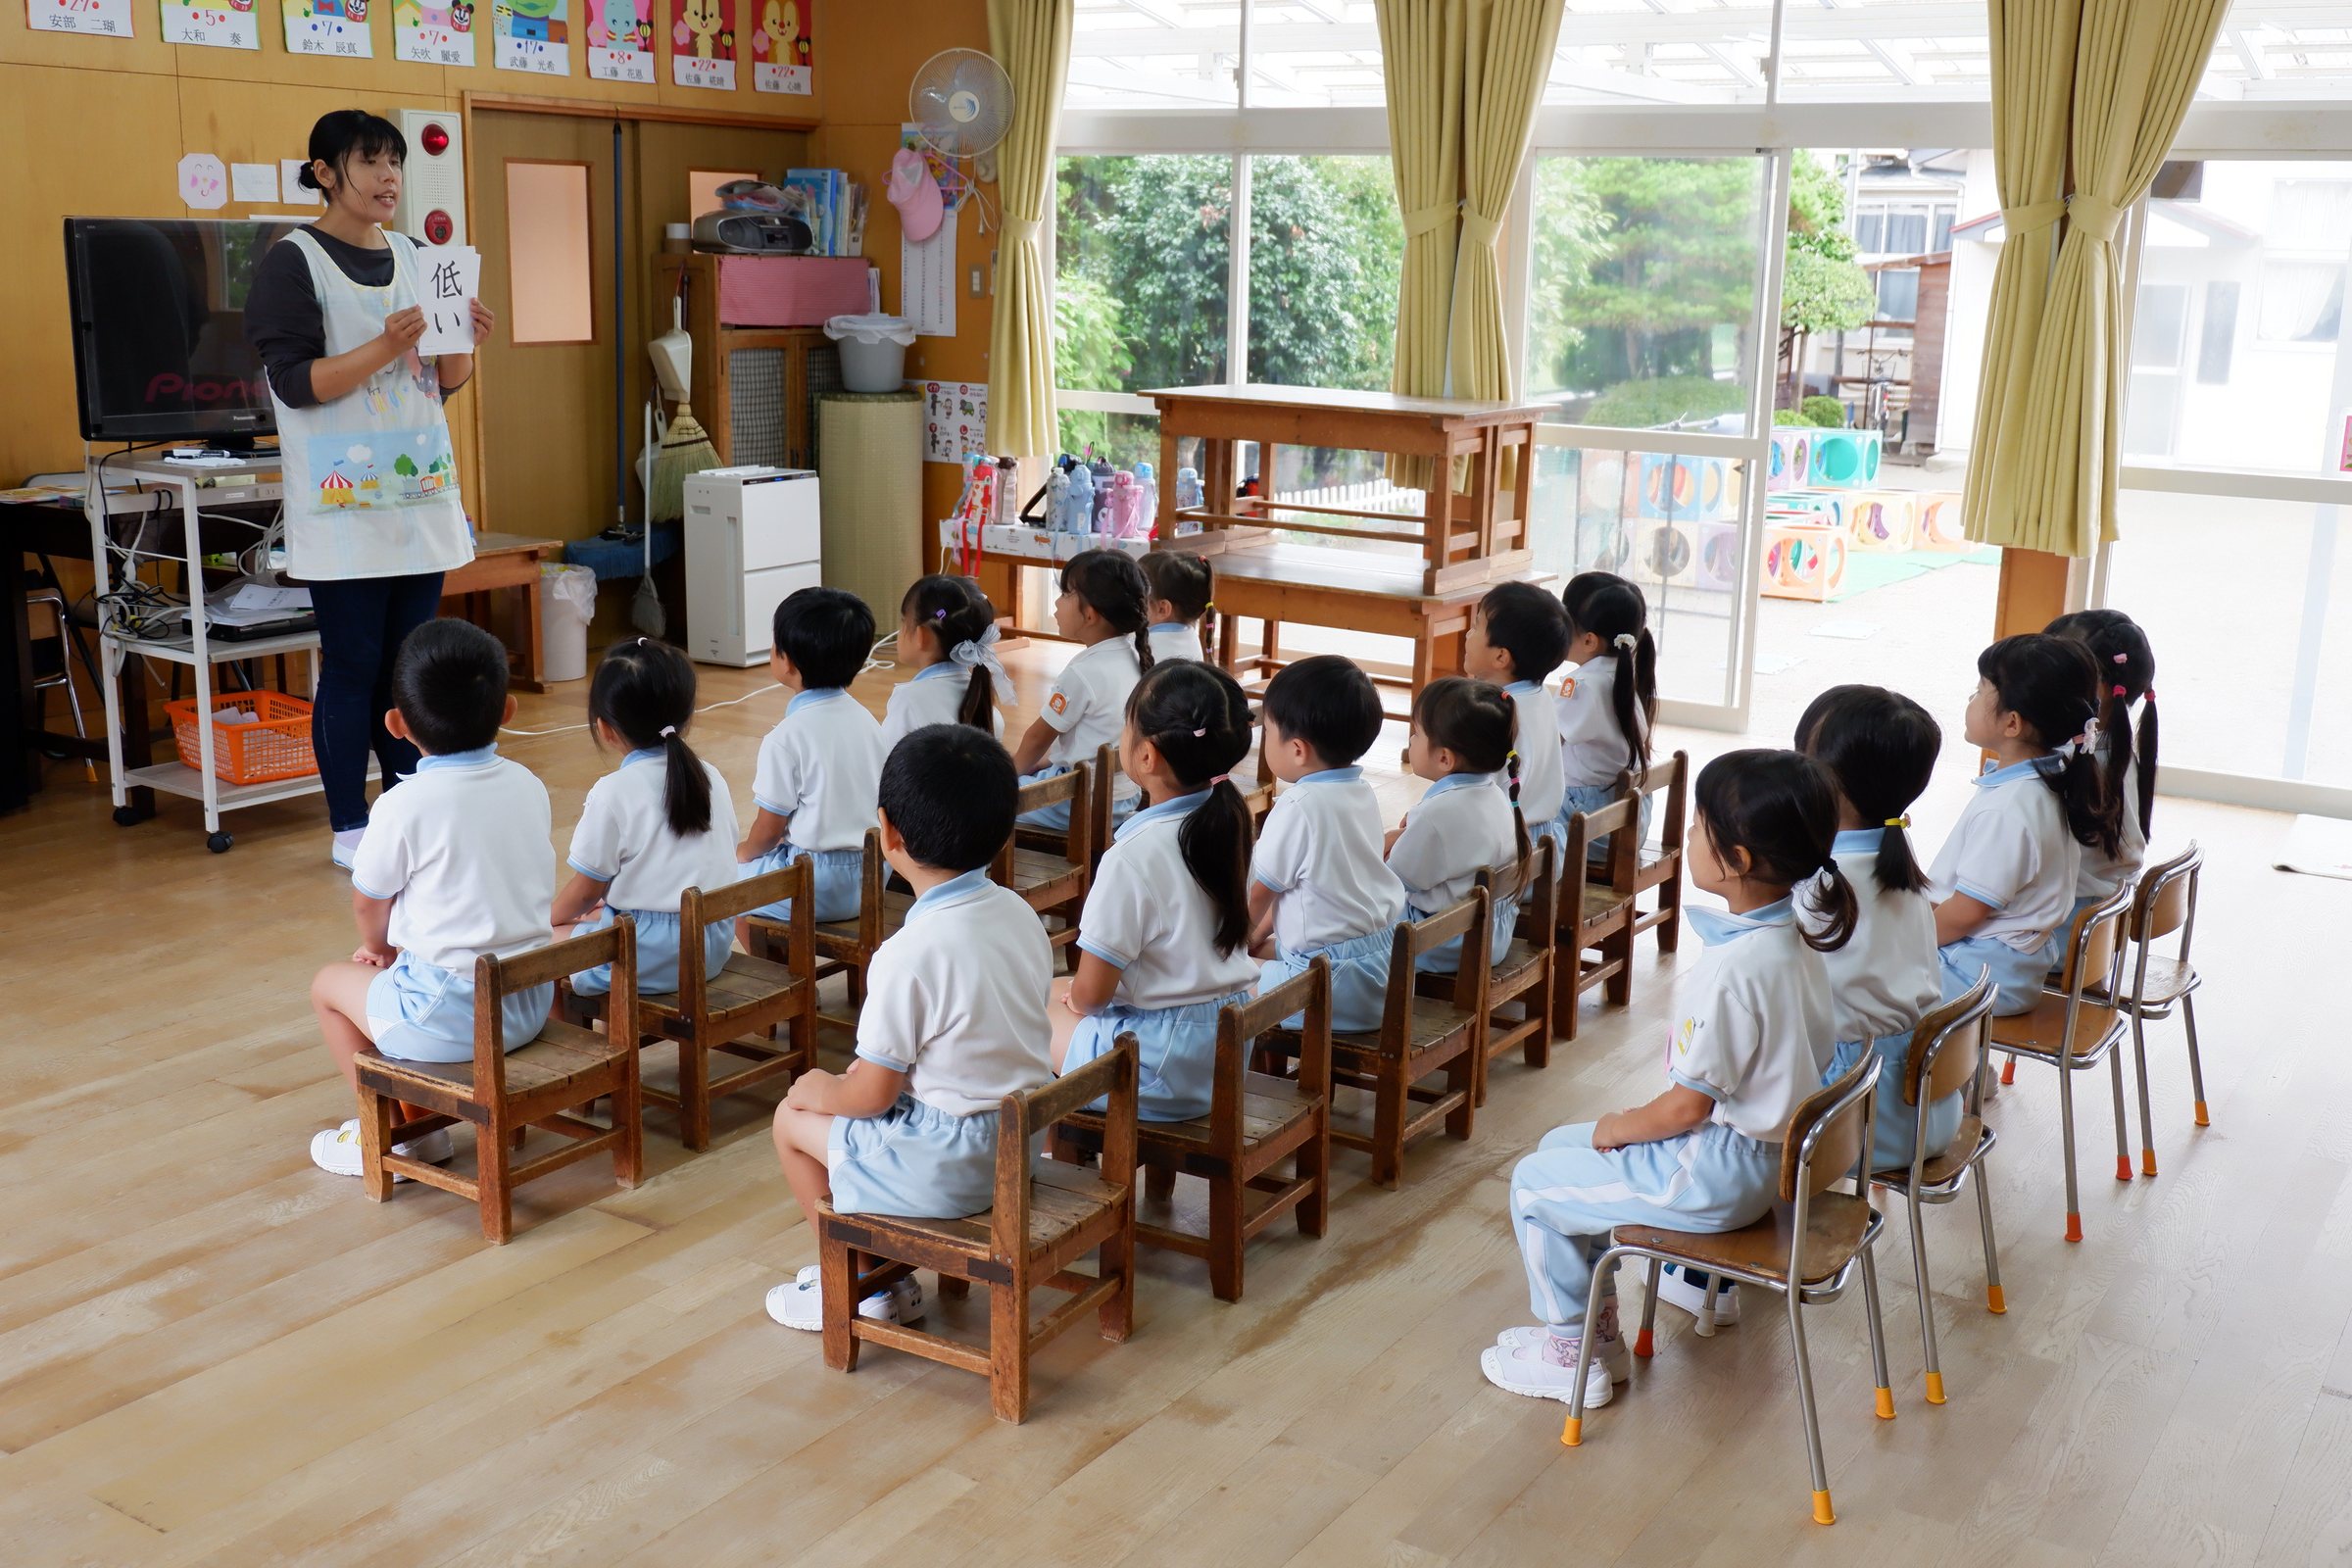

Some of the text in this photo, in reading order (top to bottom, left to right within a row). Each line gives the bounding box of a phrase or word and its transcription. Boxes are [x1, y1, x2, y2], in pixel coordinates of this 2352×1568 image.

[49, 14, 76, 28] 安部
[205, 9, 217, 26] 5
[181, 27, 206, 42] 大和
[321, 21, 333, 36] 7
[428, 29, 439, 45] 7
[302, 38, 324, 52] 鈴木
[525, 39, 538, 54] 17
[411, 46, 431, 60] 矢吹
[617, 50, 625, 64] 8
[510, 56, 528, 69] 武藤
[698, 60, 711, 72] 22
[602, 66, 618, 77] 工藤
[777, 66, 790, 77] 22
[430, 260, 463, 334] 低い
